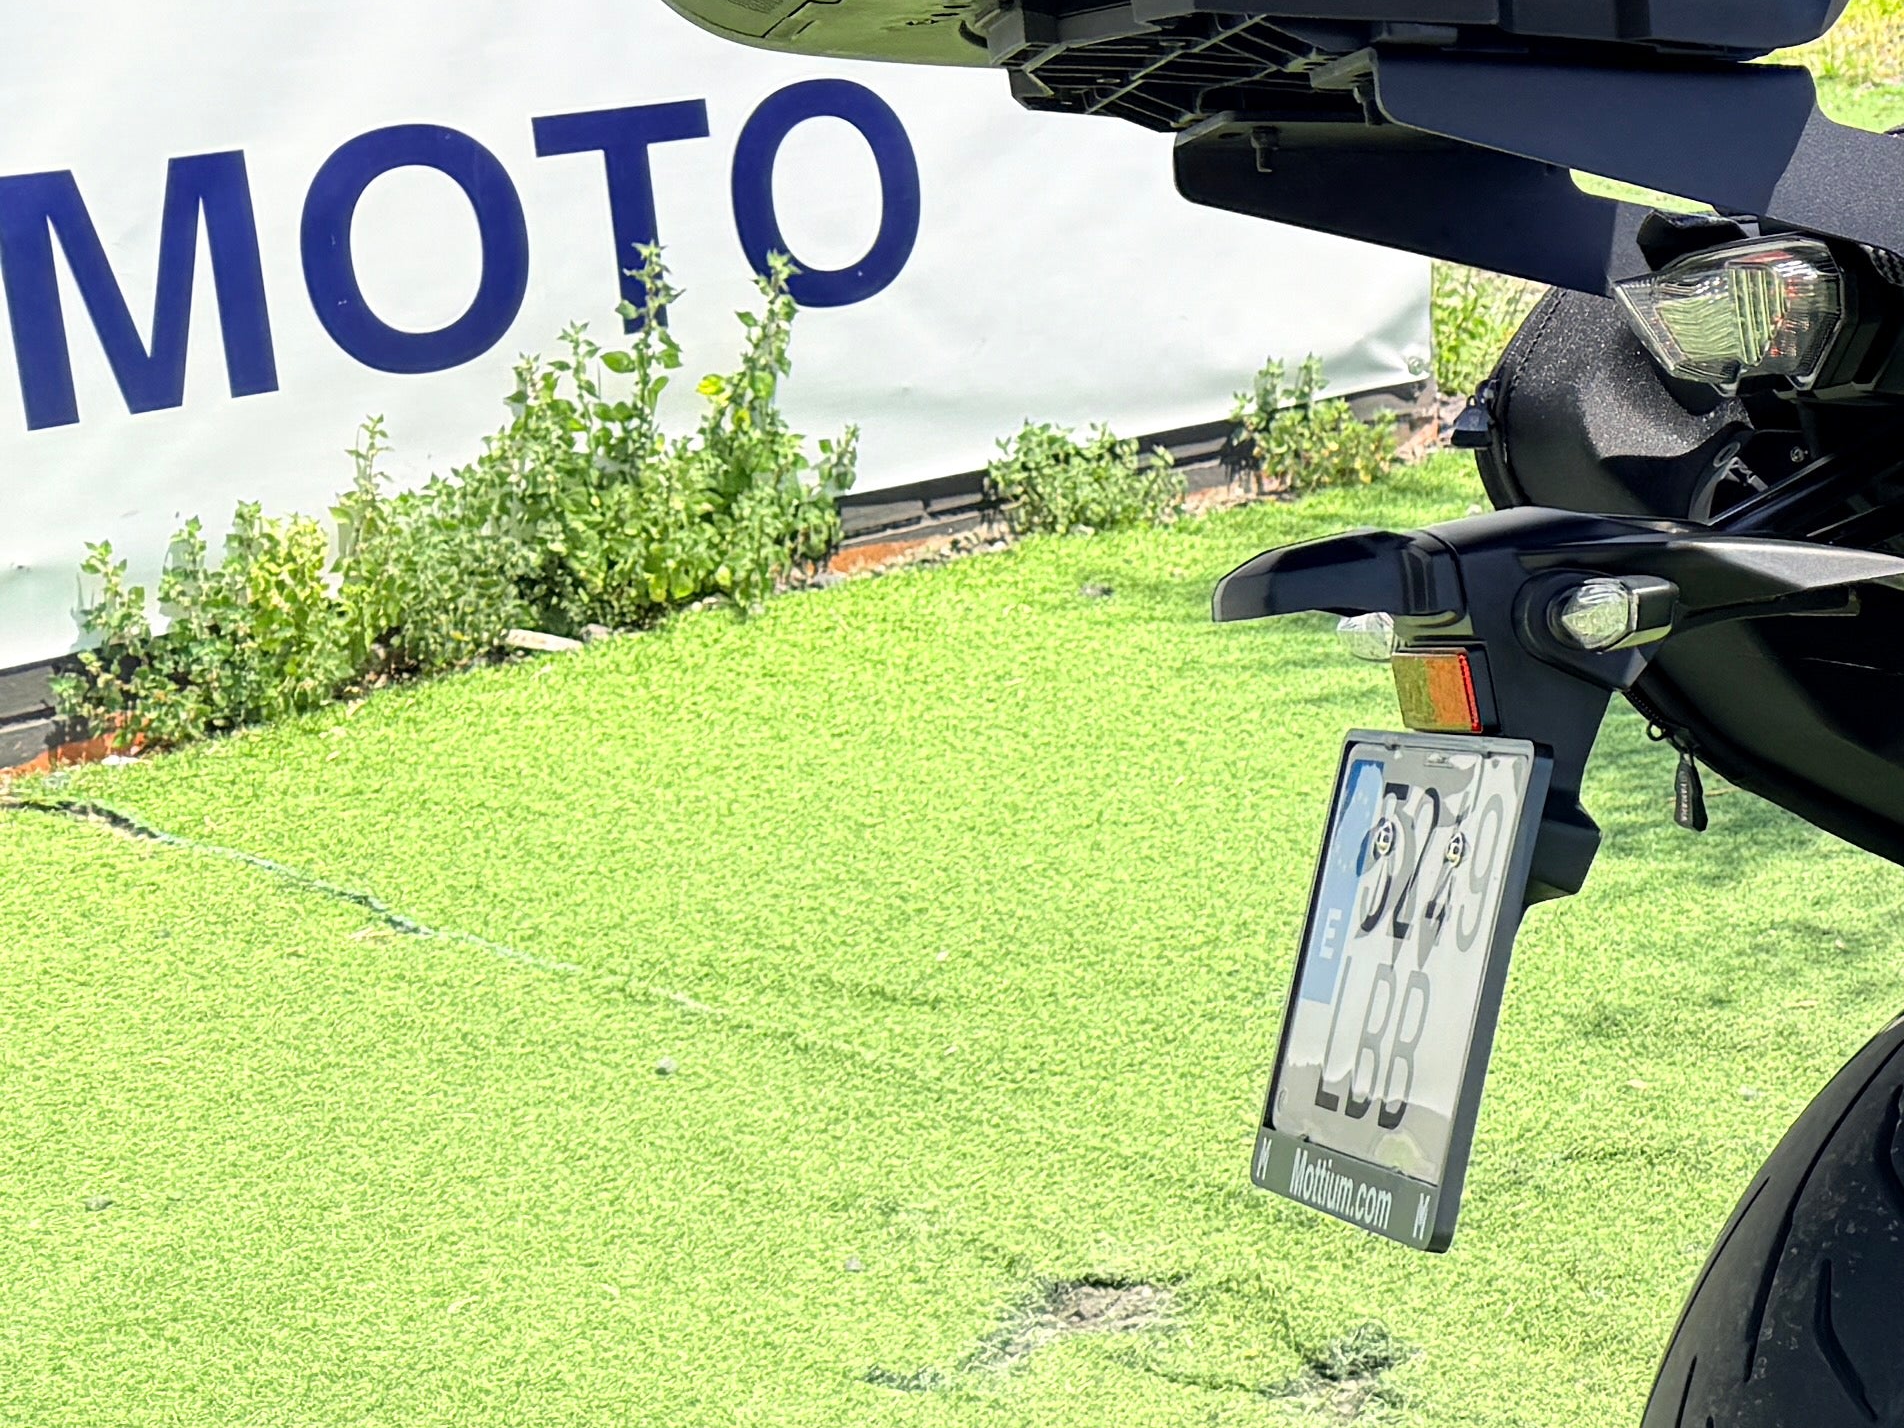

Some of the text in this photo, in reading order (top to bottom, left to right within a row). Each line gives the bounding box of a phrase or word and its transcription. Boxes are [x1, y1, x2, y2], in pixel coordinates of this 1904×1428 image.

[0, 78, 921, 431] MOTO
[1313, 955, 1431, 1130] LBB
[1290, 1148, 1394, 1232] Mottium.com
